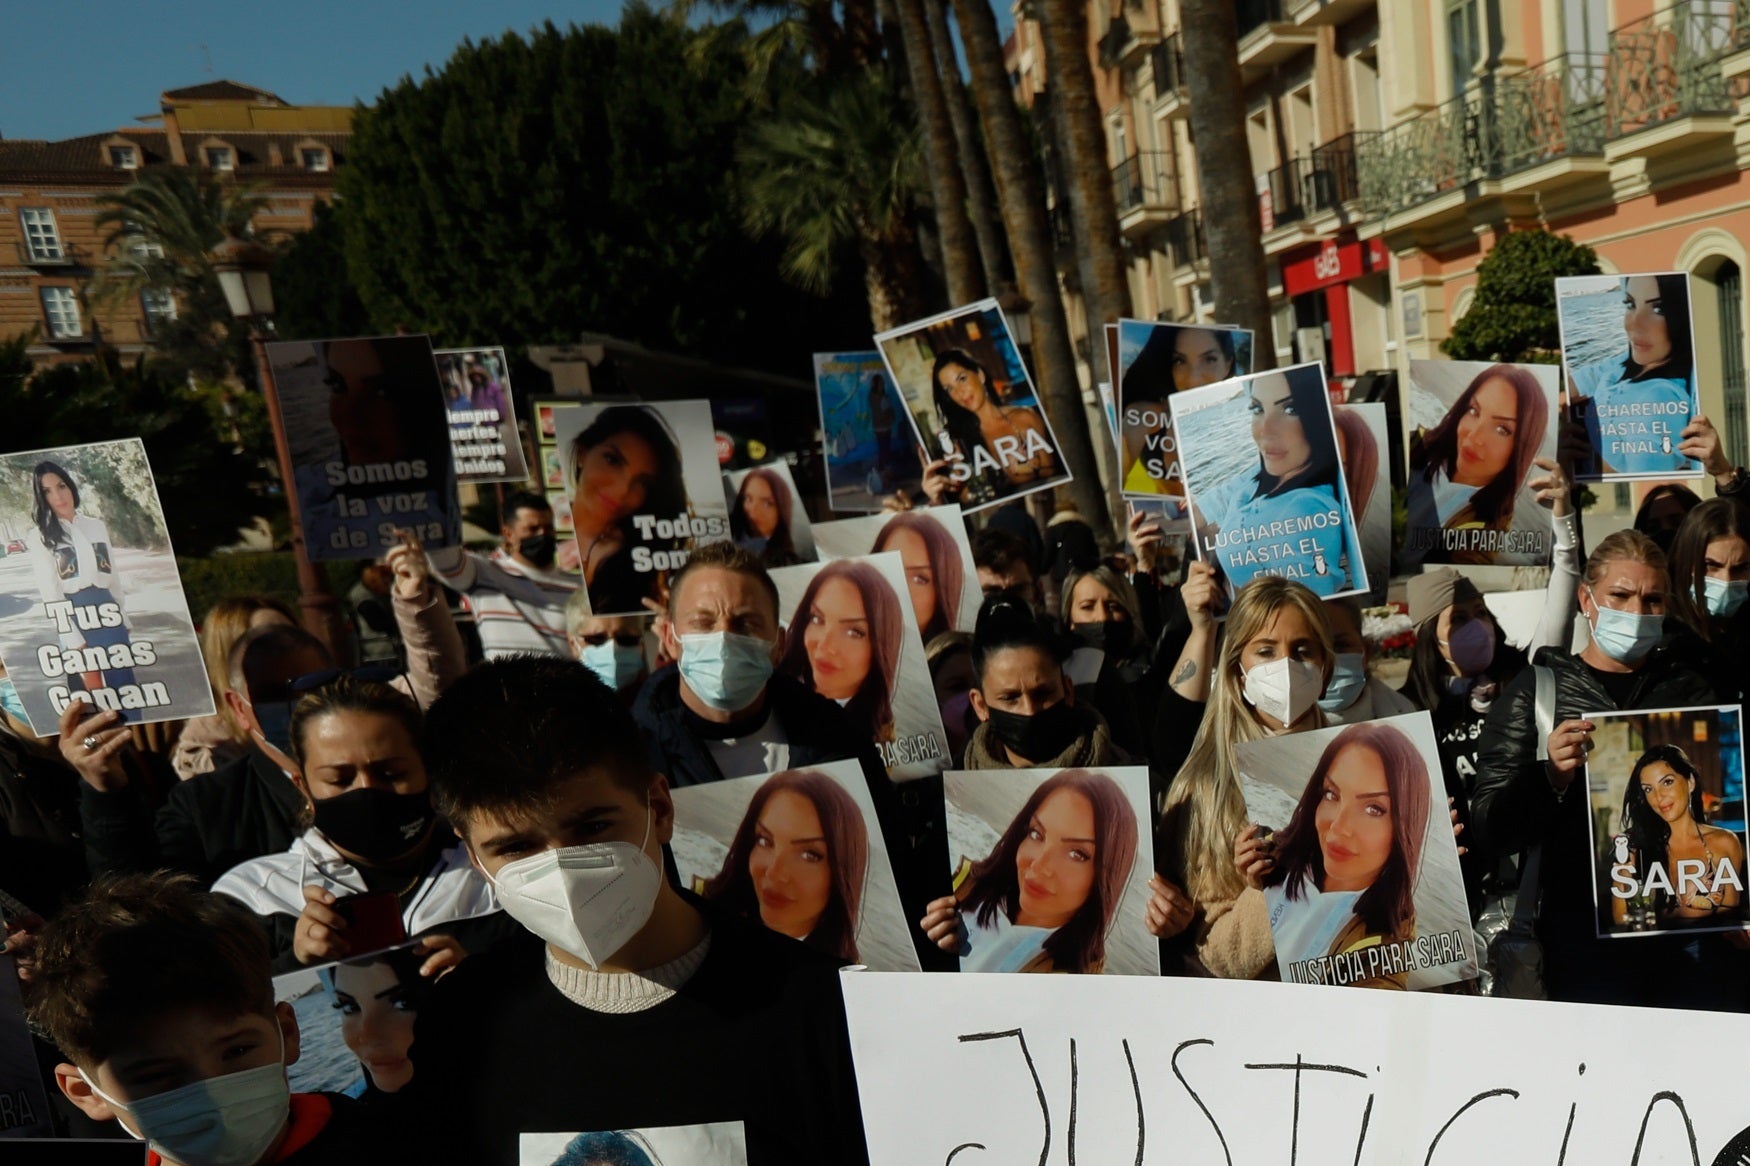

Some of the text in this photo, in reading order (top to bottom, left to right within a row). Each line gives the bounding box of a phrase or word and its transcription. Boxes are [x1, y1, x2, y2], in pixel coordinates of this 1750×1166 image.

[1127, 408, 1174, 429] SOM
[1652, 421, 1673, 434] EL
[949, 427, 1055, 483] SARA
[1144, 434, 1177, 453] VO
[1611, 440, 1659, 455] FINAL
[325, 459, 429, 487] Somos
[1146, 458, 1183, 480] SA
[336, 490, 429, 518] la voz
[329, 526, 368, 549] de
[632, 512, 725, 541] Todos
[1204, 510, 1342, 551] LUCHAREMOS
[1411, 527, 1544, 553] JUSTICIA PARA SARA
[630, 545, 692, 573] Som
[1229, 537, 1325, 568] HASTA EL
[45, 600, 124, 633] Tus
[37, 641, 157, 677] Ganas
[898, 732, 943, 763] SARA
[1609, 857, 1744, 899] SARA
[1367, 940, 1417, 978] PARA
[1416, 930, 1467, 967] SARA
[0, 1088, 37, 1129] RA
